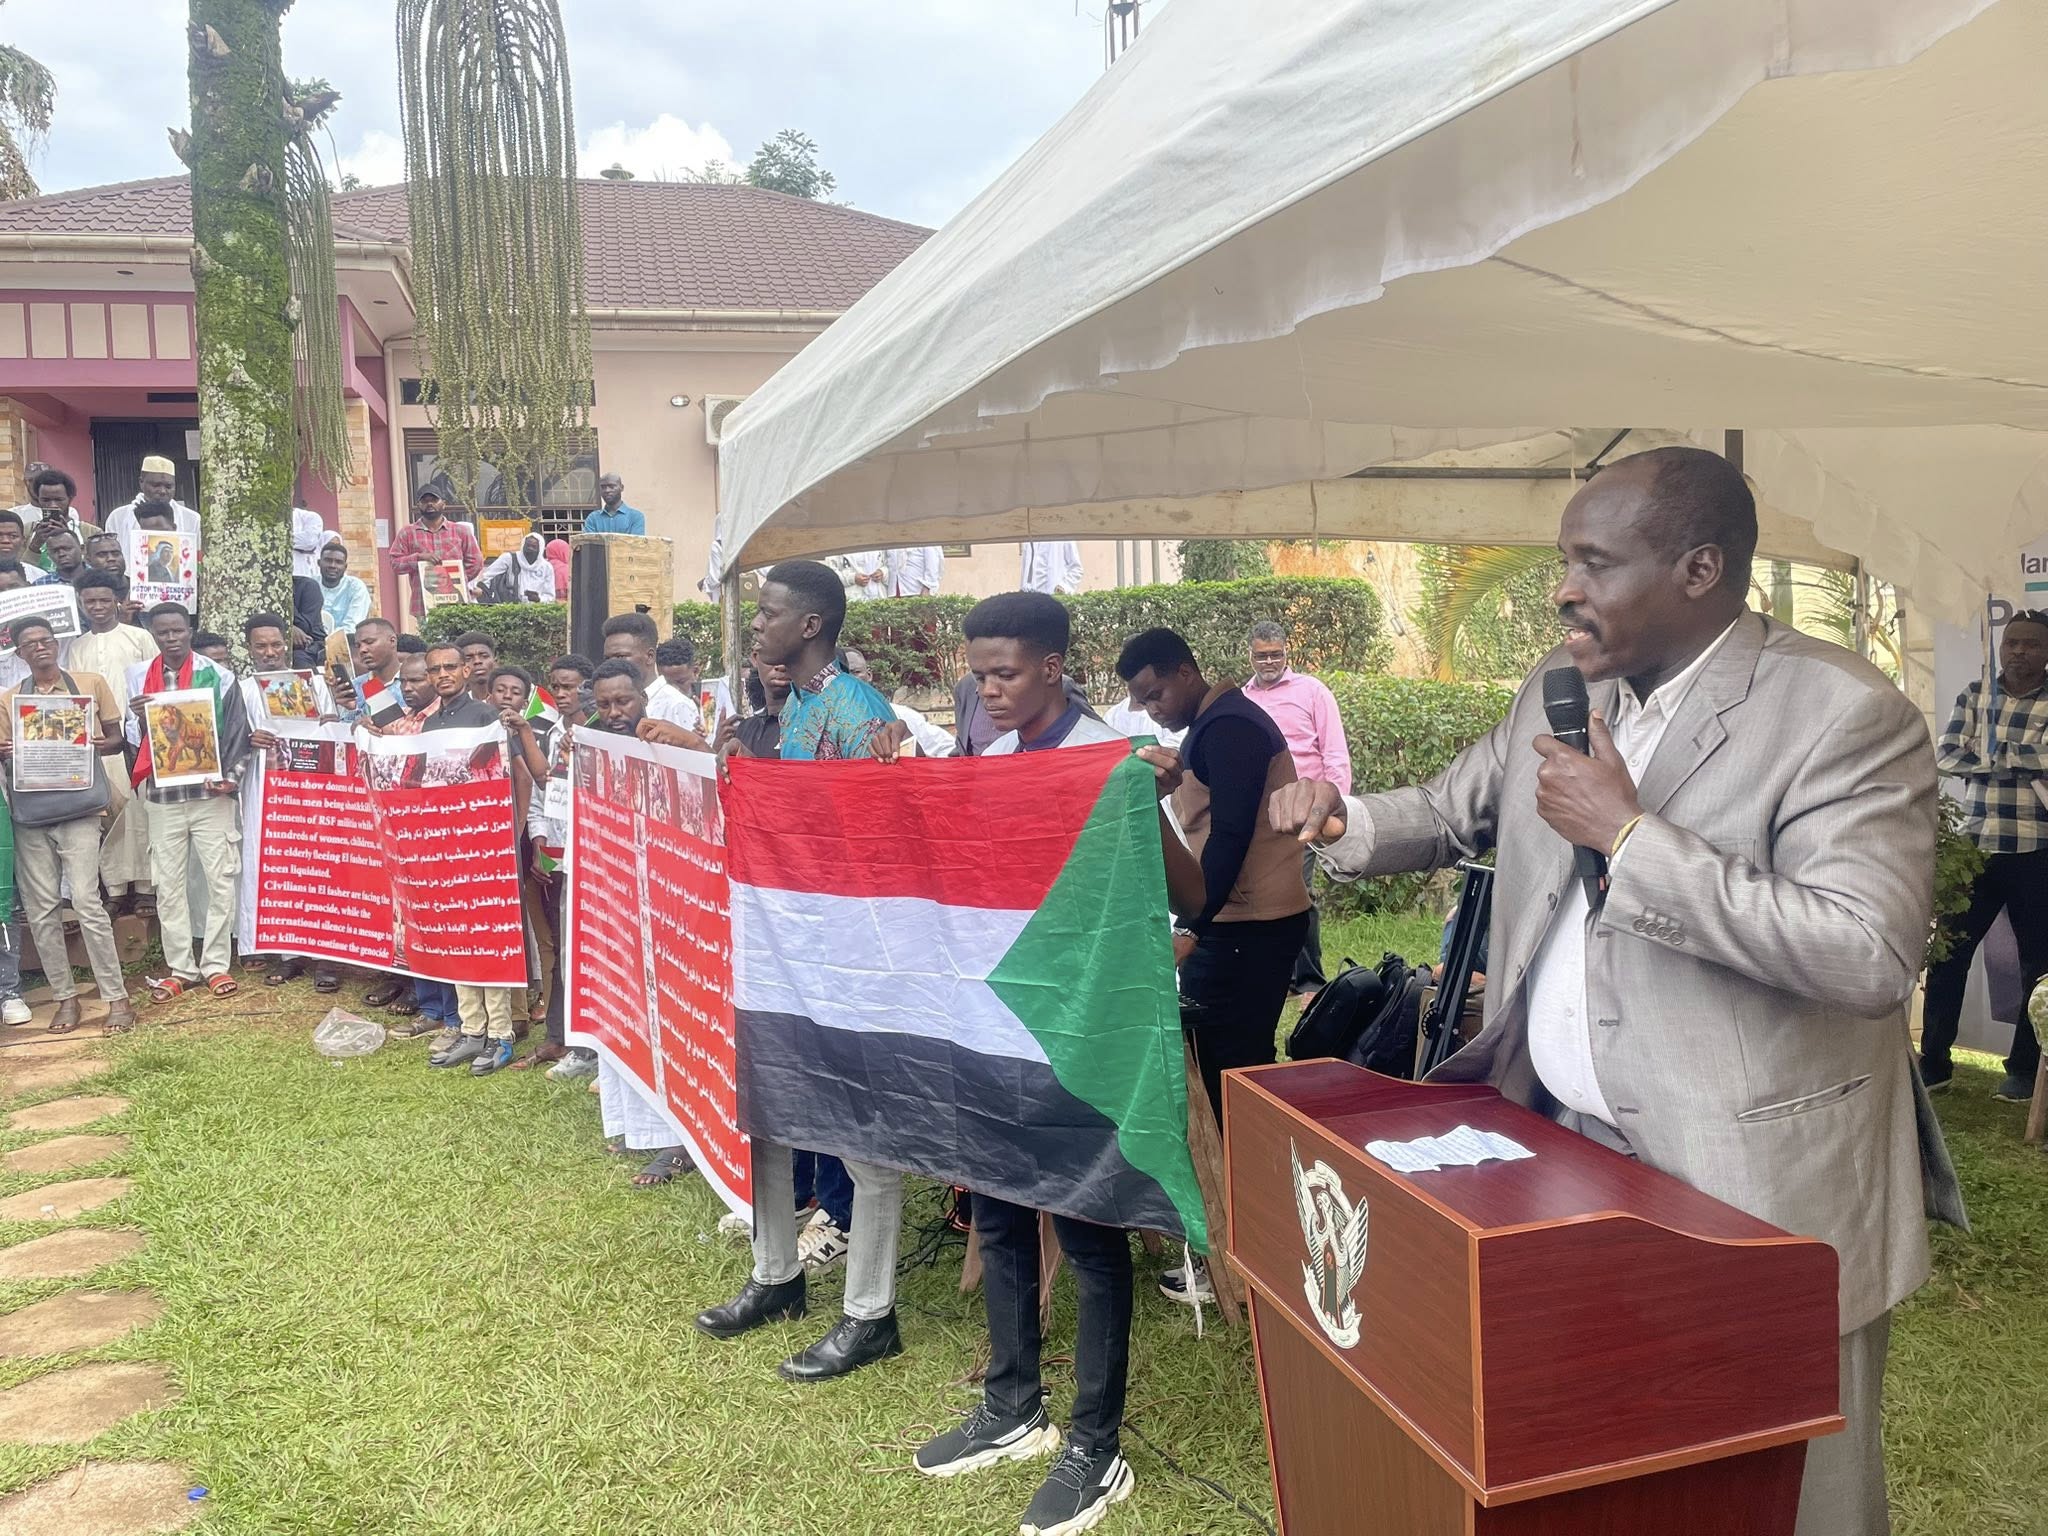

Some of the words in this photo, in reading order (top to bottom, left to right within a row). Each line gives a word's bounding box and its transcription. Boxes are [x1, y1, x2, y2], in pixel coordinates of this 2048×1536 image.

[269, 776, 299, 788] Videos
[300, 778, 324, 790] show
[302, 799, 322, 807] men
[324, 798, 344, 812] being
[440, 798, 466, 815] فيديو
[266, 812, 306, 823] elements
[307, 815, 316, 824] of
[319, 815, 336, 826] RSF
[265, 828, 308, 841] hundreds
[309, 832, 318, 842] of
[319, 835, 349, 846] women,
[453, 821, 488, 837] تعرضوا
[264, 846, 282, 856] the
[284, 847, 312, 860] elderly
[313, 850, 340, 863] fleeing
[342, 853, 349, 862] El
[482, 849, 494, 859] من
[263, 863, 288, 873] been
[290, 864, 331, 878] liquidated.
[264, 880, 306, 892] Civilians
[308, 884, 316, 893] in
[318, 885, 325, 894] El
[351, 892, 361, 900] are
[260, 897, 292, 908] threat
[294, 899, 304, 909] of
[305, 902, 340, 915] genocide,
[341, 907, 359, 918] while
[360, 909, 371, 919] the
[259, 915, 320, 929] international
[321, 920, 345, 933] silence
[359, 928, 384, 941] message
[258, 932, 276, 942] the
[278, 933, 306, 945] killers
[308, 936, 316, 945] to
[317, 939, 347, 951] continue
[349, 942, 359, 953] the
[360, 946, 389, 958] genocide
[474, 945, 499, 957] رسالة
